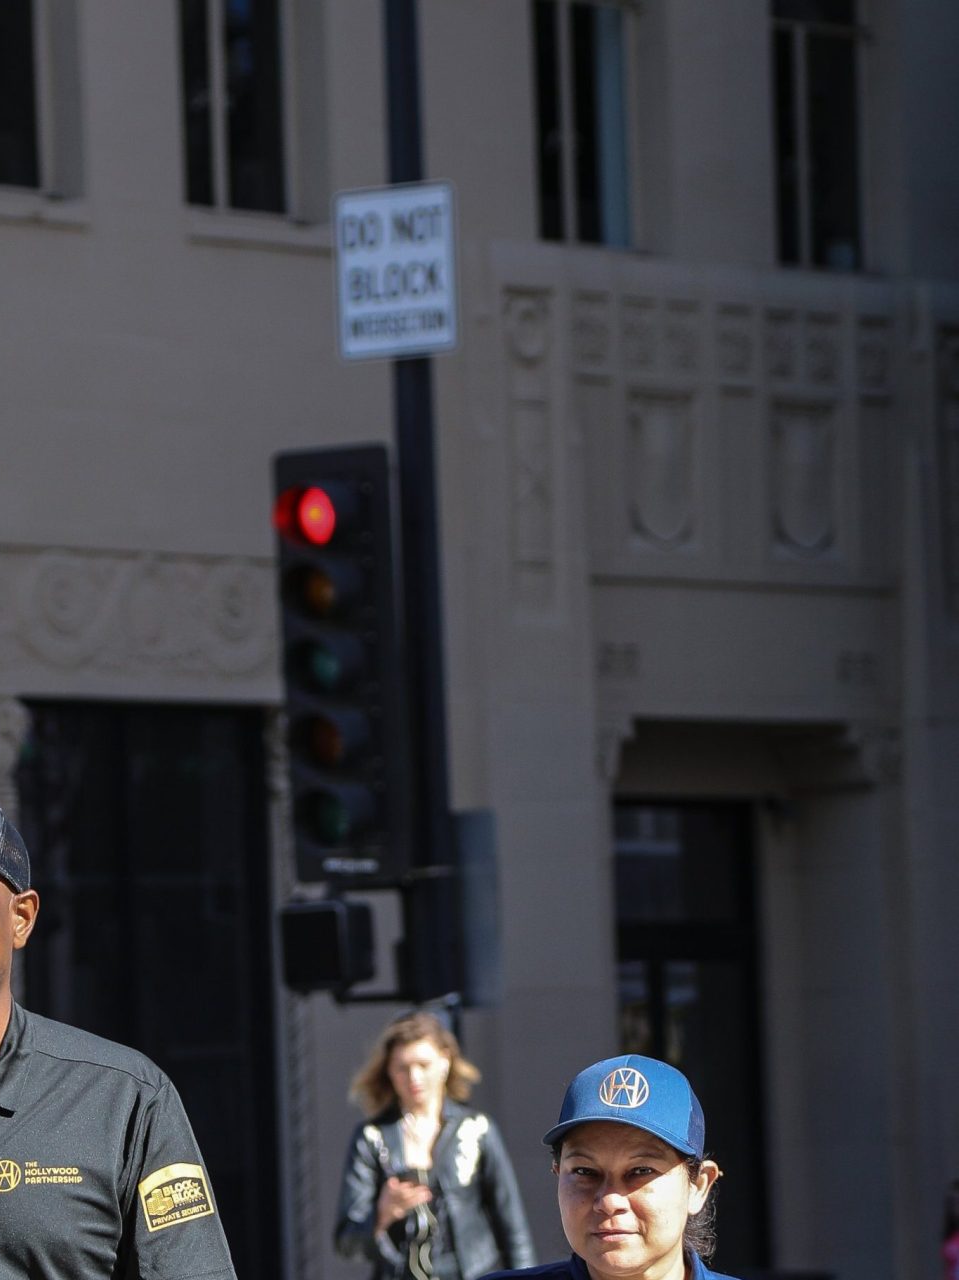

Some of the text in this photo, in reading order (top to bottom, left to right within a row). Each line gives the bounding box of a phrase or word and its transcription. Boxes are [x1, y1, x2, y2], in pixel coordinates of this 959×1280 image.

[342, 204, 442, 250] DO NOT
[349, 258, 441, 304] BLOCK
[24, 1167, 79, 1177] HOLLYWOOD
[24, 1175, 83, 1185] PARTNERSHIP
[162, 1180, 193, 1197] BLOCK
[172, 1187, 204, 1205] BLOCK
[152, 1204, 207, 1225] PRIVATE SECURITY
